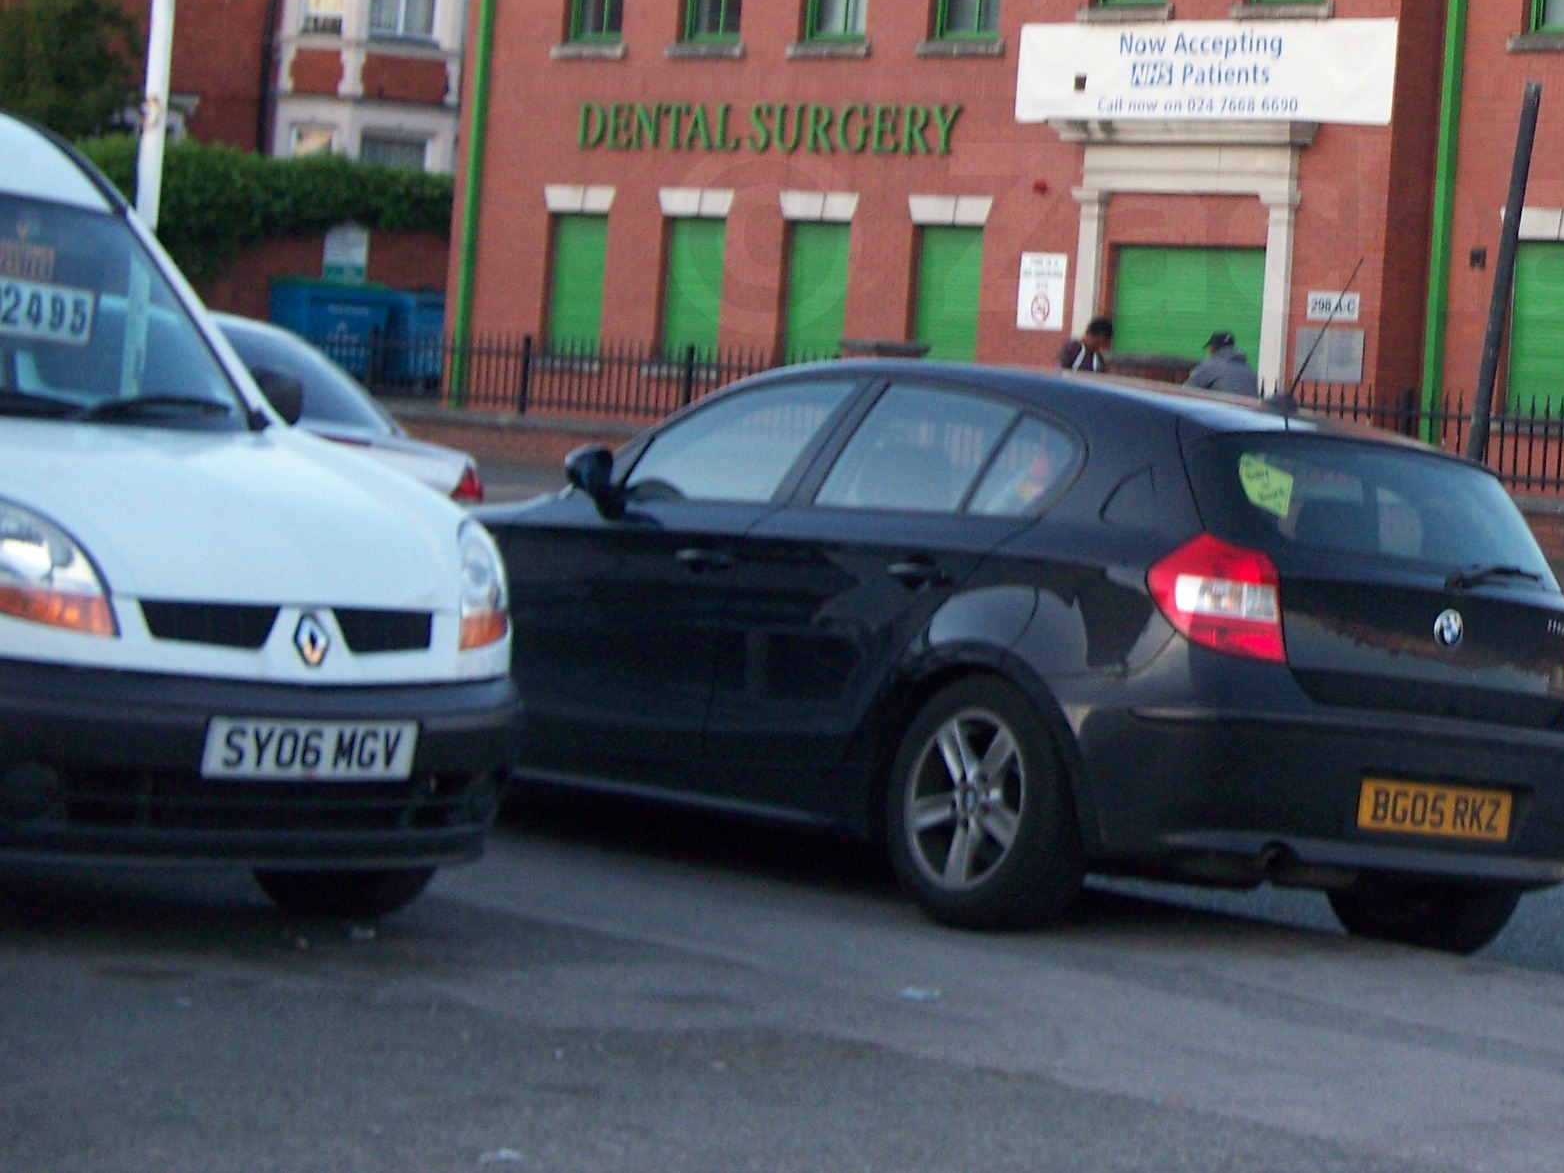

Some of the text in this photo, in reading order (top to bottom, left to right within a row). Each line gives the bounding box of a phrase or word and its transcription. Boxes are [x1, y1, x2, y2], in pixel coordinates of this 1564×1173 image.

[1119, 29, 1283, 61] Now Accepting
[1131, 61, 1271, 88] NHS Patients
[1098, 95, 1299, 114] Call now on 024 7668 6690
[576, 101, 964, 156] DENTAL SURGERY
[223, 725, 402, 771] SY06 MGV
[1371, 786, 1502, 833] BG05 RKZ
